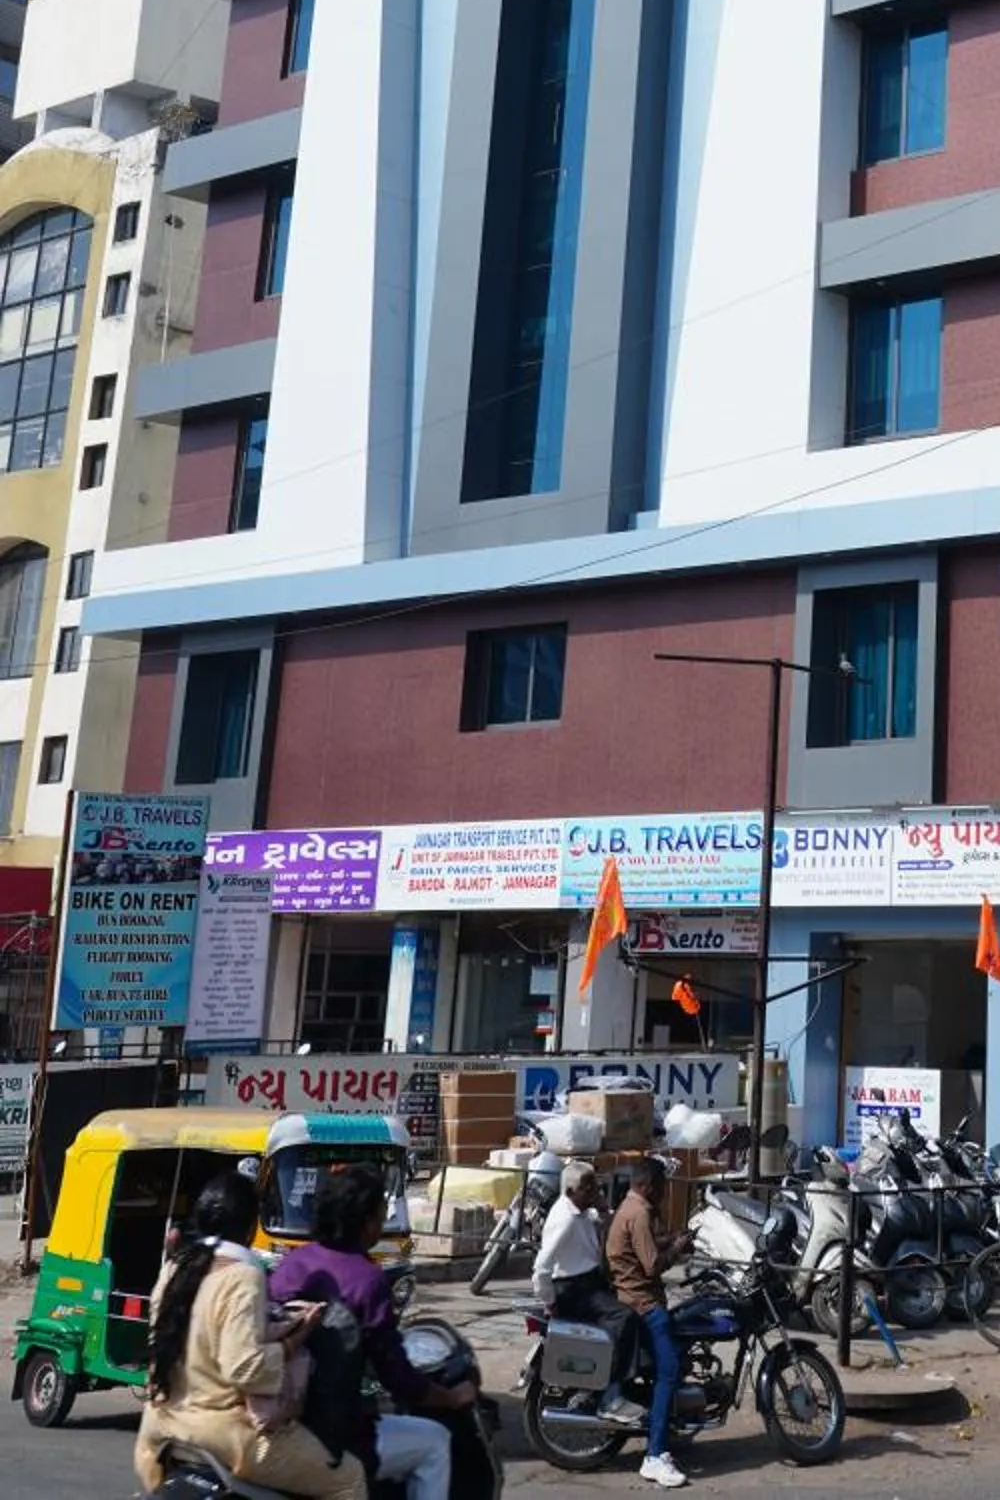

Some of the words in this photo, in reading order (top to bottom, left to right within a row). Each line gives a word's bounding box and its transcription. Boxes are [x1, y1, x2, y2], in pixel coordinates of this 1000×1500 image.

[133, 807, 202, 825] TRAVELS
[640, 823, 763, 852] TRAVELS
[794, 827, 889, 852] BONNY
[446, 865, 492, 875] PARCEL
[497, 863, 557, 874] SERVICES
[453, 877, 493, 891] RAJKOT
[502, 875, 557, 891] JAMNAGAR
[73, 891, 115, 909] BIKE
[120, 892, 145, 910] ON
[151, 893, 198, 911] RENT
[299, 1068, 400, 1103] પાયલ
[851, 1087, 922, 1103] JARAM
